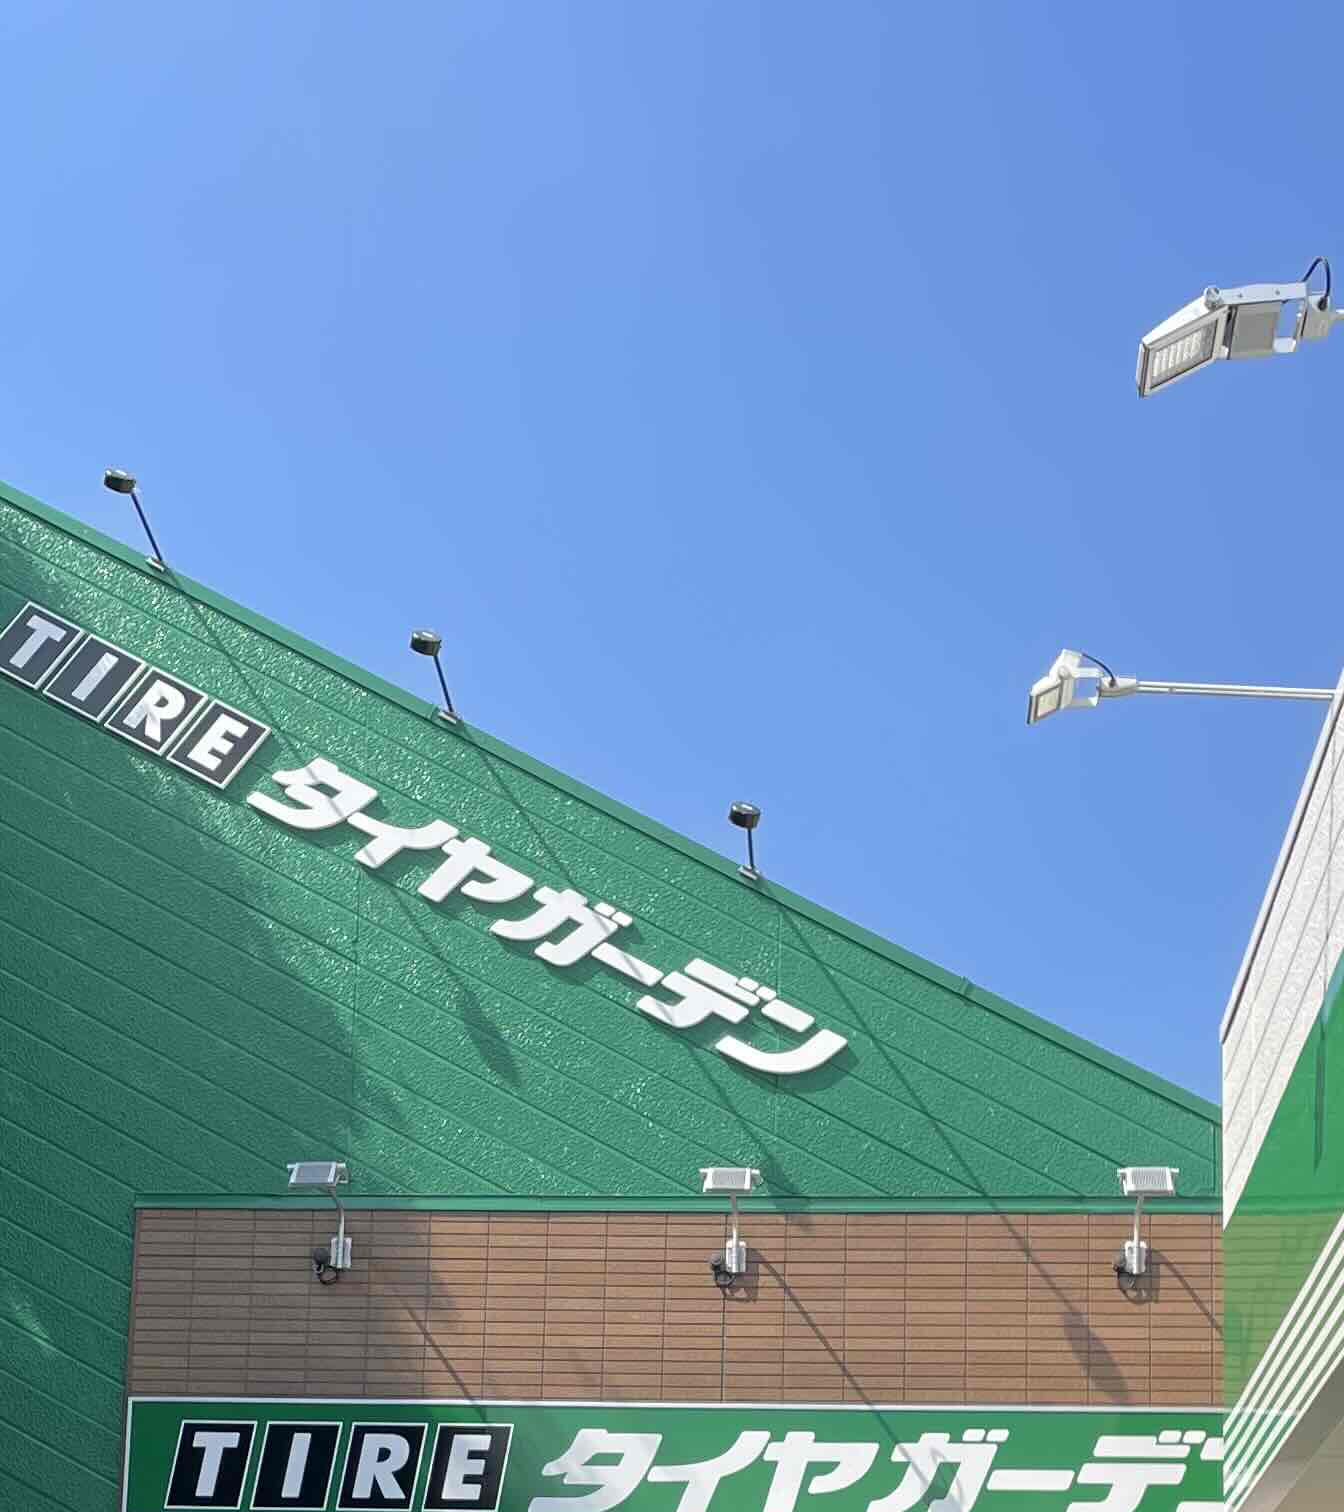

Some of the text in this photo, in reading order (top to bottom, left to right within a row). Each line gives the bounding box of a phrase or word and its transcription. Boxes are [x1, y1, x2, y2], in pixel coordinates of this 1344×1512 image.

[7, 613, 848, 1075] TIRE タイヤガーデン
[190, 1430, 494, 1501] TIRE
